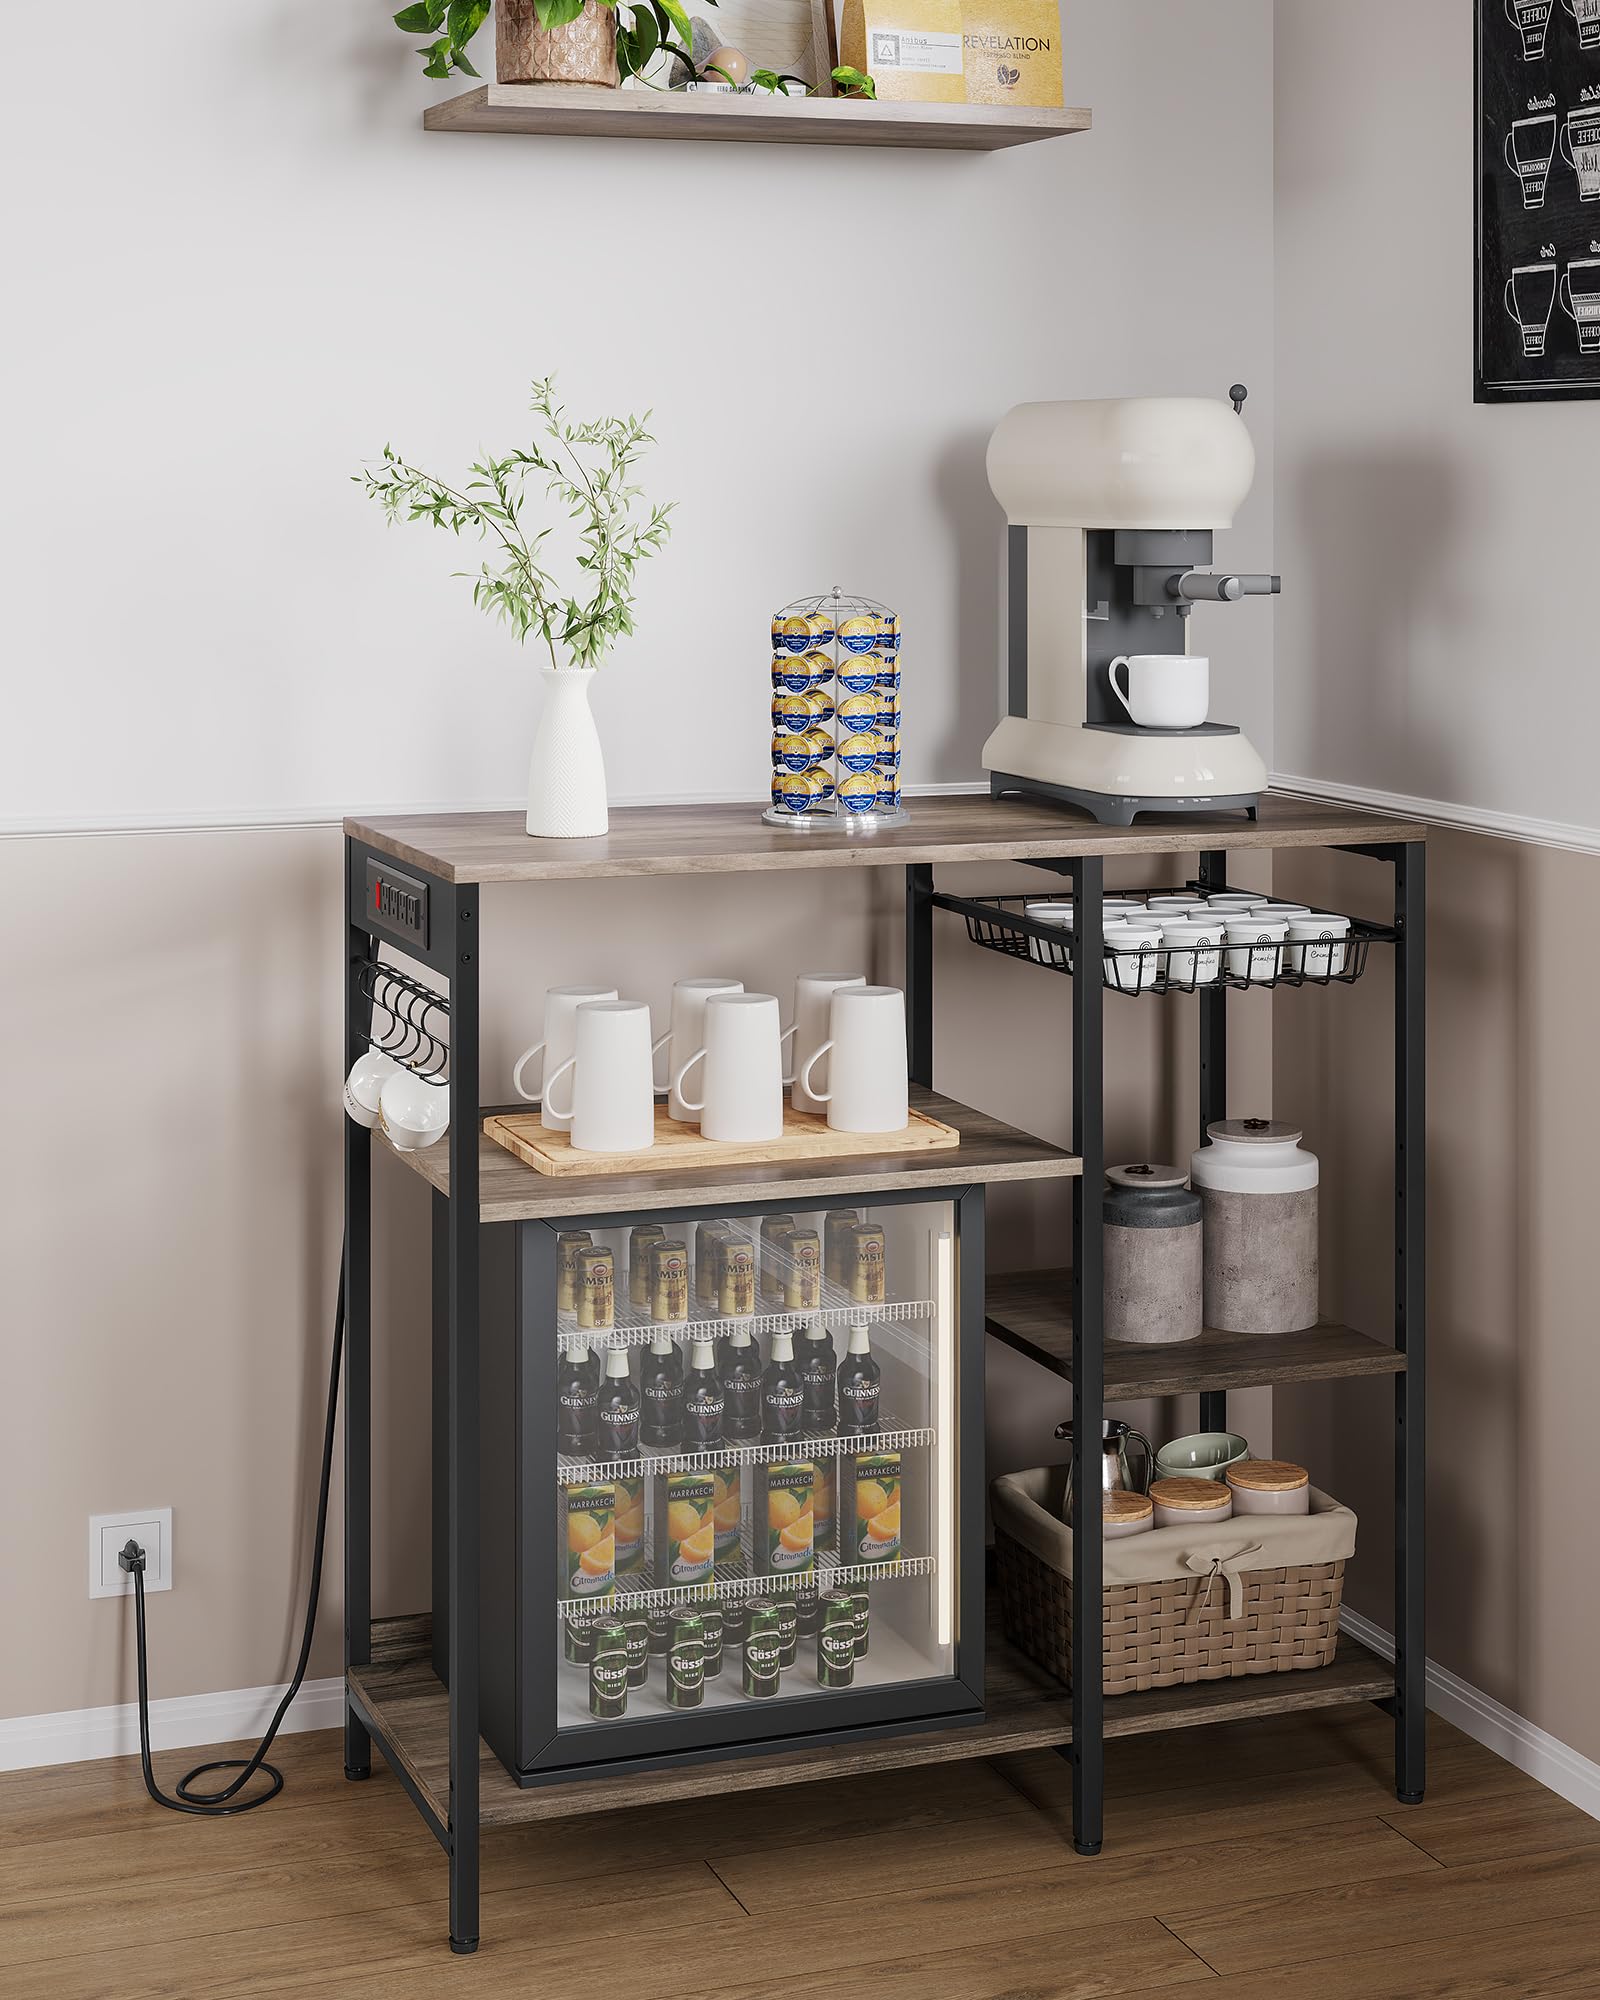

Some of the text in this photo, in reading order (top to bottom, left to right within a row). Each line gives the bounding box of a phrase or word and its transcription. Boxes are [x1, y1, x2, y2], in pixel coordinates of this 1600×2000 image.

[963, 35, 1050, 51] REVELATION
[858, 1466, 900, 1477] MARRAKECH
[770, 1476, 813, 1487] MARRAKECH
[670, 1487, 714, 1498] MARRAKECH
[569, 1498, 614, 1509] MARRAKECH
